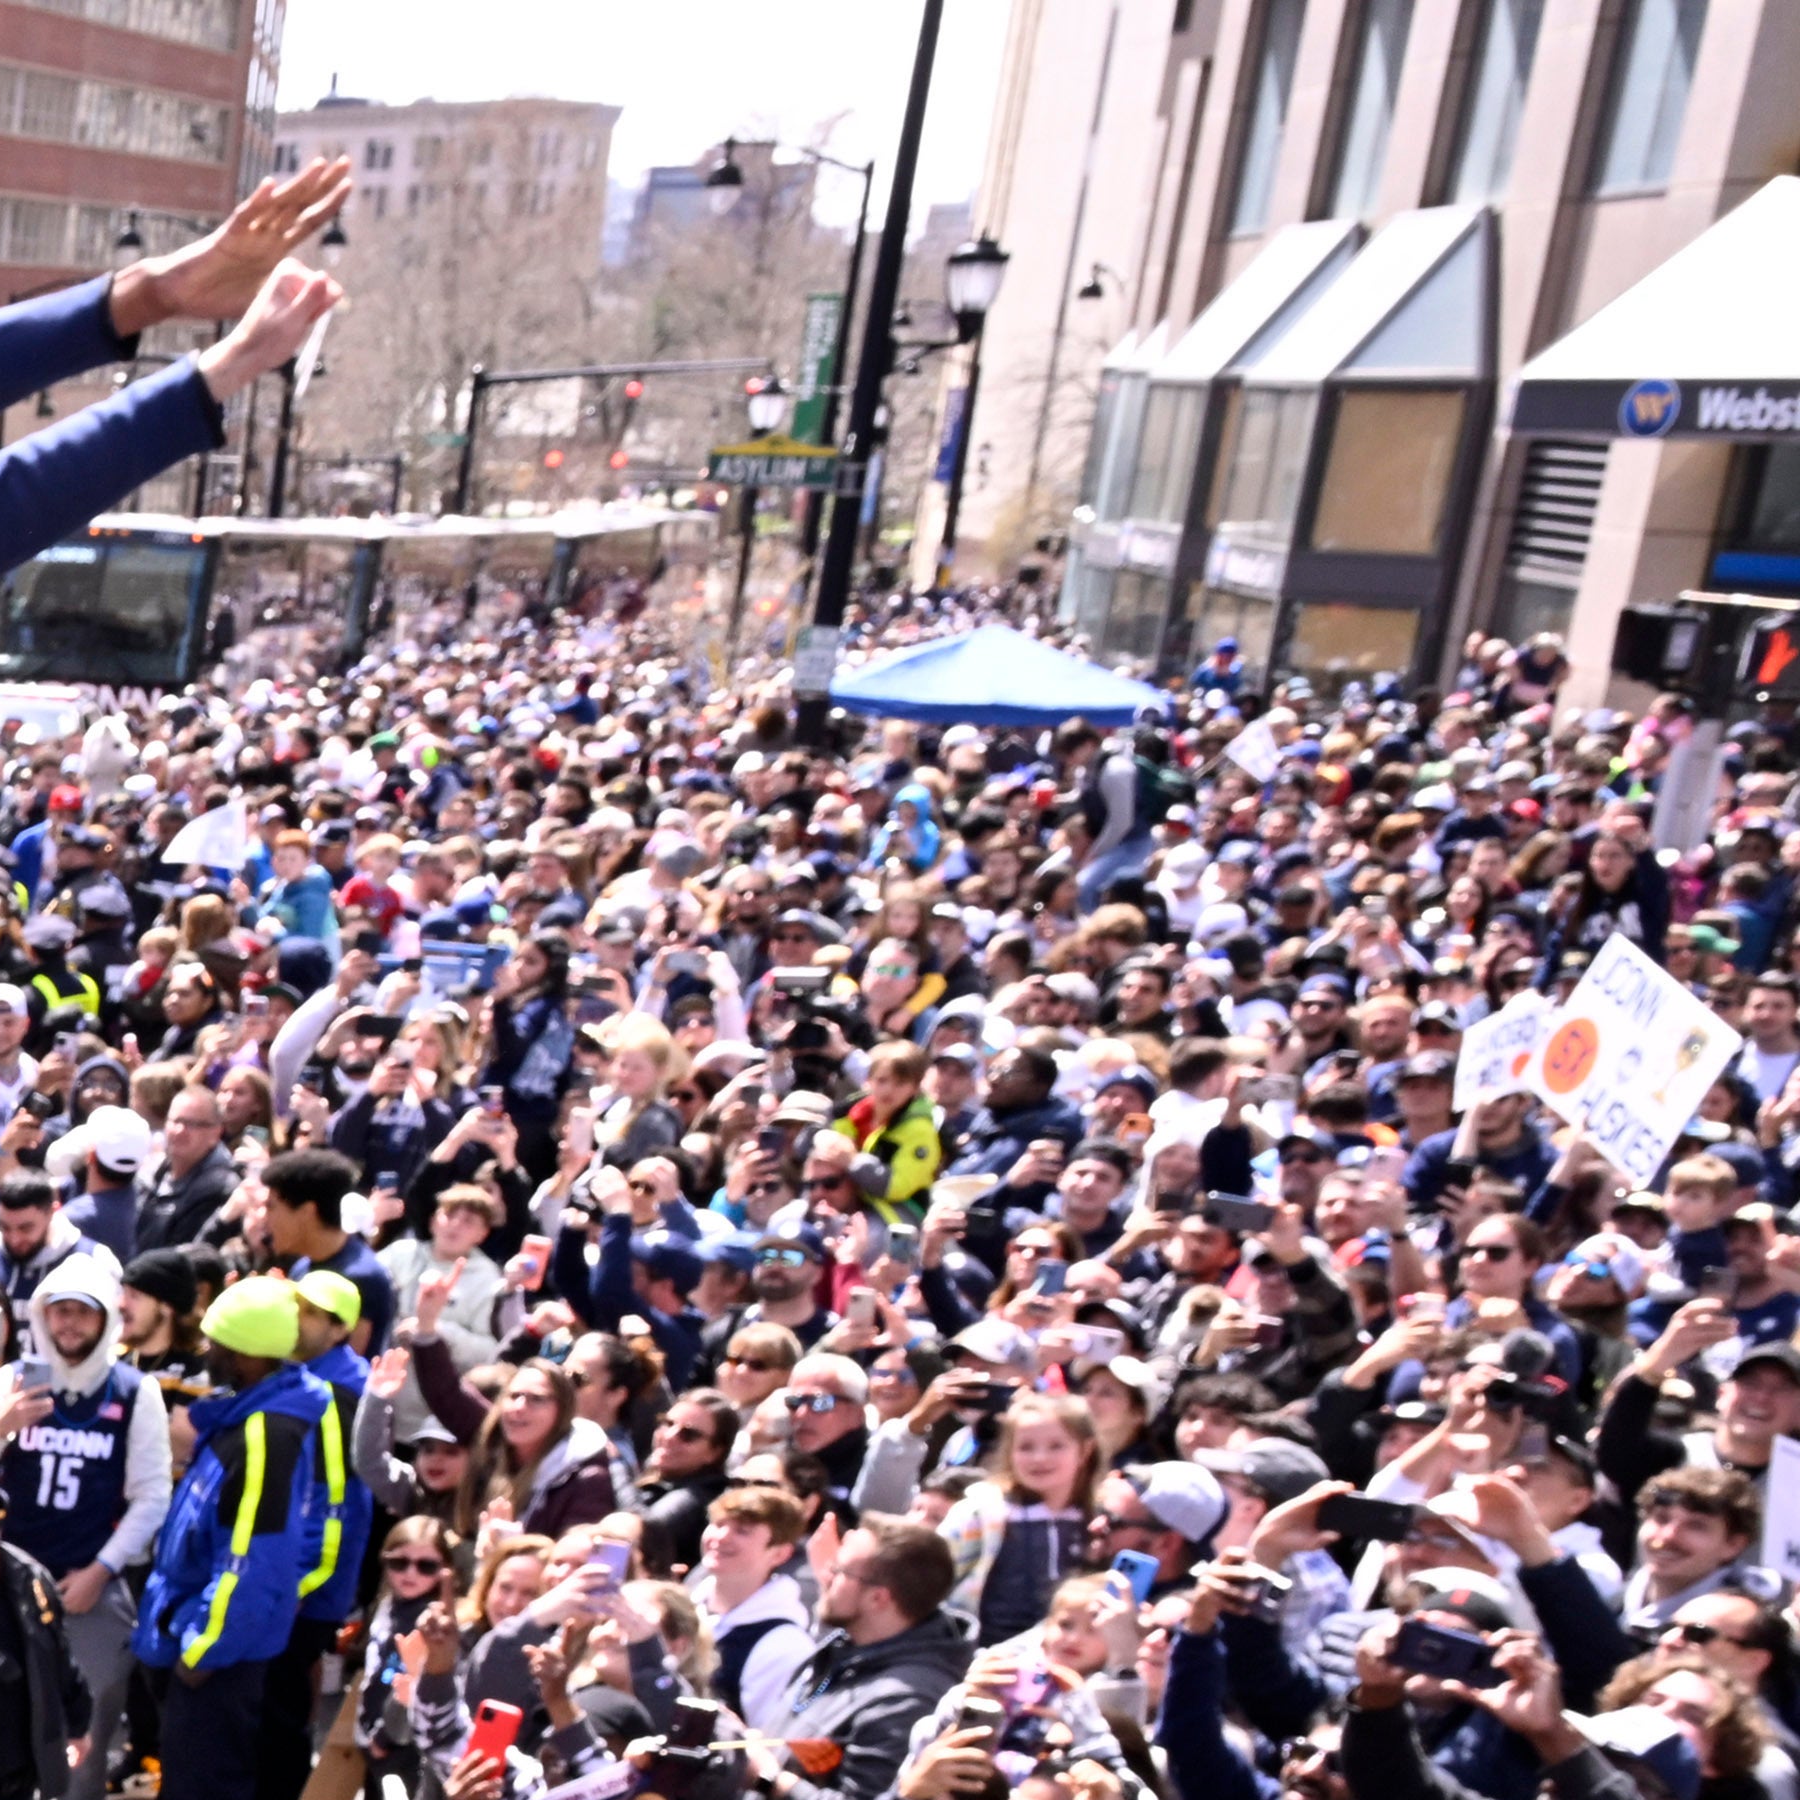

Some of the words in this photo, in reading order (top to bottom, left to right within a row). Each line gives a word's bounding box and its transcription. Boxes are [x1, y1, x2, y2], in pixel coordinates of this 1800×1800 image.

[713, 456, 809, 483] ASYLUM
[1576, 1080, 1666, 1178] HUSKIES
[18, 1424, 115, 1460] UCONN
[36, 1452, 82, 1511] 15
